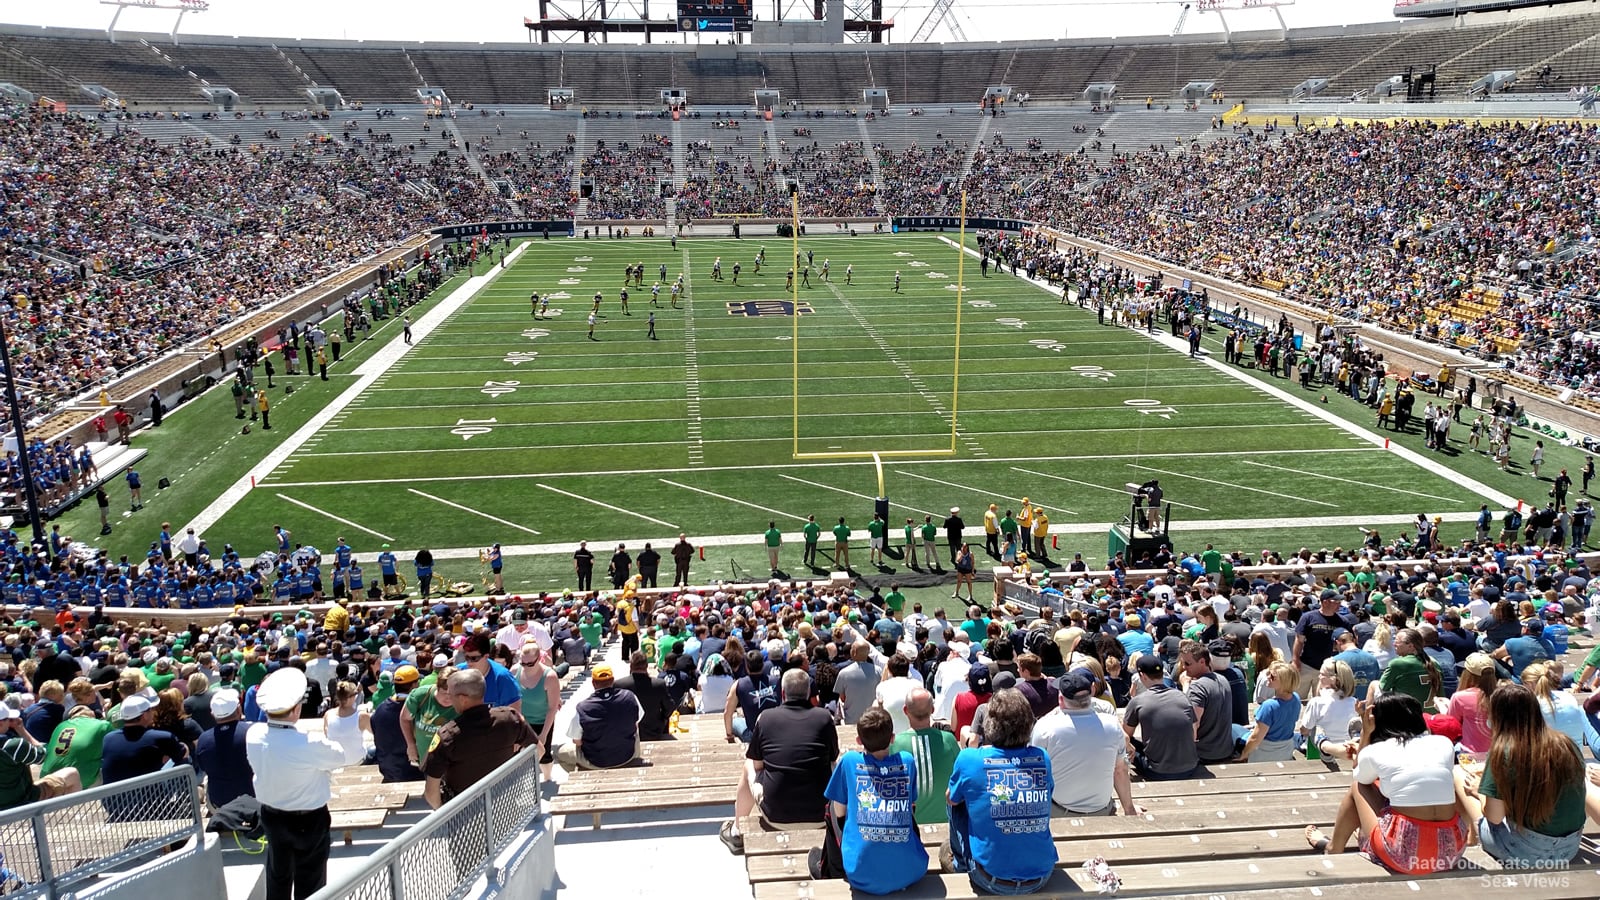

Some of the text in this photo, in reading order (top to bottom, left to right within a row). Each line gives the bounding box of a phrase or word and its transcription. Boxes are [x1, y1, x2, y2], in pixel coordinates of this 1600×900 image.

[901, 218, 969, 226] FIGHTING
[480, 380, 521, 393] 20
[1123, 399, 1178, 415] 10
[450, 417, 497, 434] 10
[55, 727, 76, 757] 9
[856, 775, 910, 799] RISE
[986, 768, 1047, 792] RISE
[1016, 790, 1048, 804] ABOVE
